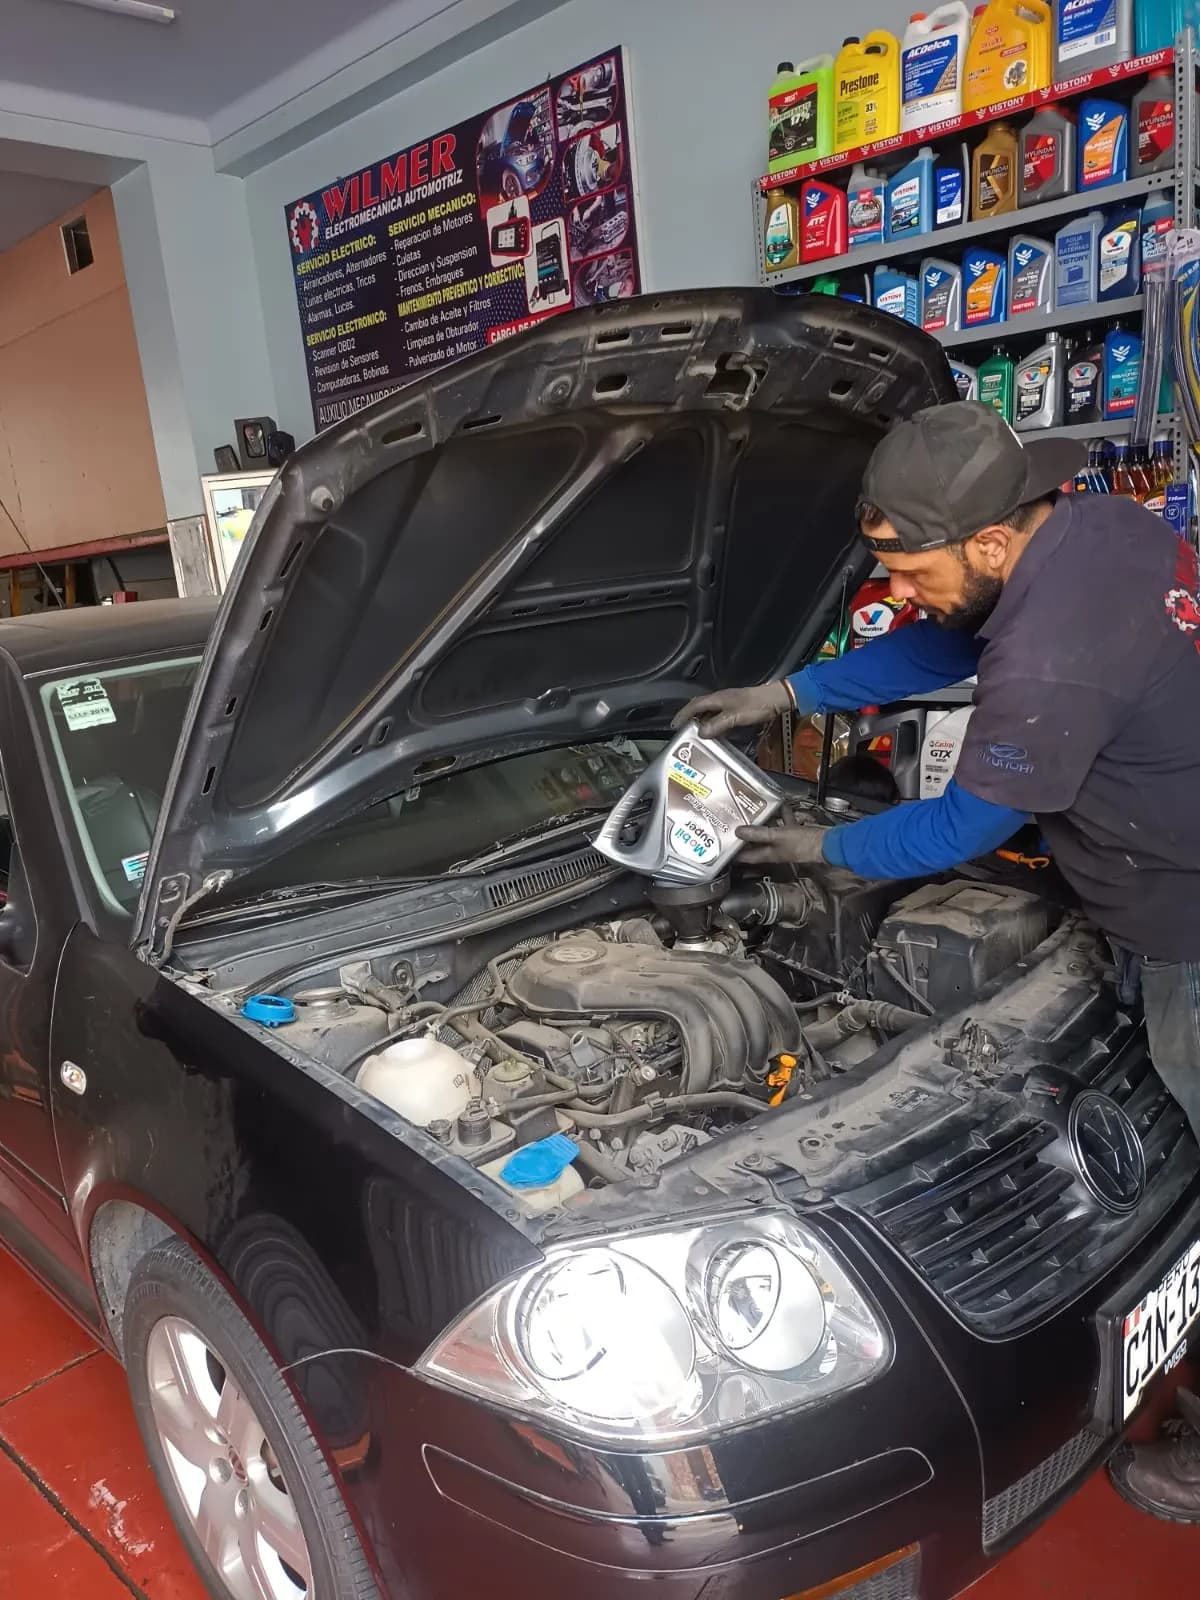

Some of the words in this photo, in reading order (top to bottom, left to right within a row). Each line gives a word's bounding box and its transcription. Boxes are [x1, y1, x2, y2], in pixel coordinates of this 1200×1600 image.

[907, 40, 950, 59] ACDelco
[1124, 52, 1166, 70] VISTONY
[840, 72, 879, 96] Prestone
[1054, 74, 1093, 92] VISTONY
[988, 96, 1024, 112] VISTONY
[928, 116, 962, 132] VISTONY
[1139, 112, 1174, 128] HYUNDAI
[872, 135, 904, 150] VISTONY
[820, 152, 848, 166] VISTONY
[1024, 146, 1056, 158] HYUNDAI
[322, 133, 456, 224] WILMER
[770, 168, 798, 182] VISTONY
[980, 165, 1008, 177] HYUNDAI
[325, 196, 402, 240] ELECTROMECANICA
[404, 169, 464, 208] AUTOMOTRIZ
[388, 212, 426, 237] SERVICIO
[428, 192, 476, 221] MECANICO:
[807, 216, 825, 226] ATF
[394, 226, 431, 252] Reparacion
[432, 226, 442, 236] de
[442, 212, 474, 232] Motores
[296, 254, 330, 276] SERVICIO
[331, 234, 376, 264] ELECTRICO:
[396, 249, 422, 266] Culatas
[1058, 244, 1089, 255] BATERIAS
[346, 252, 387, 274] Alternadores
[398, 265, 430, 282] Direccion
[430, 262, 435, 272] y
[436, 246, 478, 269] Suspension
[1058, 254, 1088, 265] VISTONY
[356, 274, 376, 288] Tricos
[426, 266, 464, 288] Embragues
[478, 276, 484, 290] Y
[484, 262, 525, 288] CORRECTIVO:
[880, 293, 902, 302] VISTONY
[404, 319, 429, 333] Cambio
[430, 314, 439, 324] de
[440, 306, 462, 322] Aceite
[462, 305, 468, 316] y
[469, 298, 492, 313] Filtros
[306, 328, 336, 346] SERVICIO
[338, 310, 388, 336] ELECTRONICO:
[406, 332, 436, 351] Limpieza
[436, 330, 444, 342] de
[446, 319, 480, 338] Obturador
[490, 325, 516, 343] CARGA
[312, 345, 337, 362] Scanner
[338, 338, 356, 353] OBD2
[408, 349, 446, 368] Pulverizado
[446, 346, 456, 356] de
[456, 340, 478, 354] Motor
[314, 360, 340, 377] Revision
[340, 358, 349, 370] de
[350, 350, 379, 368] Sensores
[362, 364, 390, 380] Bobinas
[319, 400, 348, 424] AUXILIO
[930, 750, 952, 758] GTX
[673, 762, 698, 778] 5W-30
[674, 828, 706, 858] Mobil
[685, 820, 714, 848] Super
